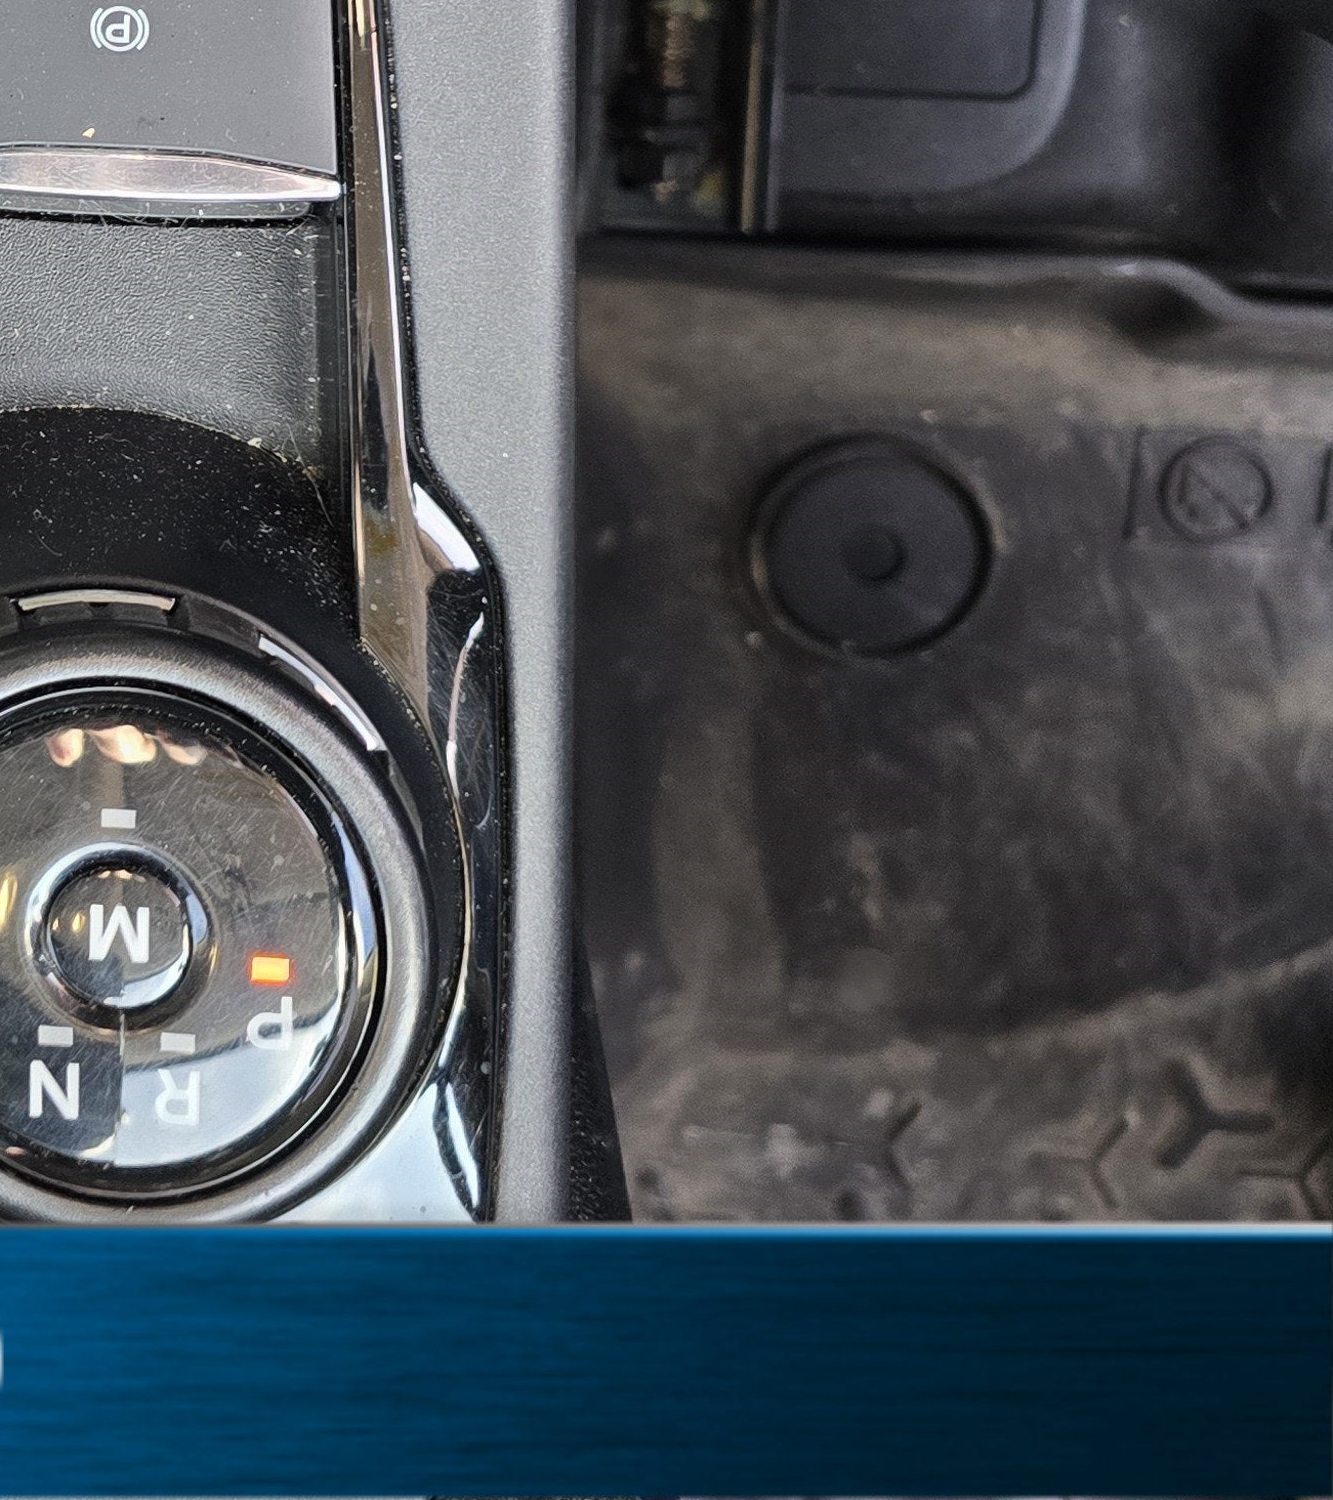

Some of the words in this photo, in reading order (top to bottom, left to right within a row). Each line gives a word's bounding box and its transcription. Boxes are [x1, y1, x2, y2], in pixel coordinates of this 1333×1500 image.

[88, 902, 151, 964] M
[244, 994, 295, 1052] P
[27, 1058, 81, 1122] N
[153, 1067, 203, 1127] R
